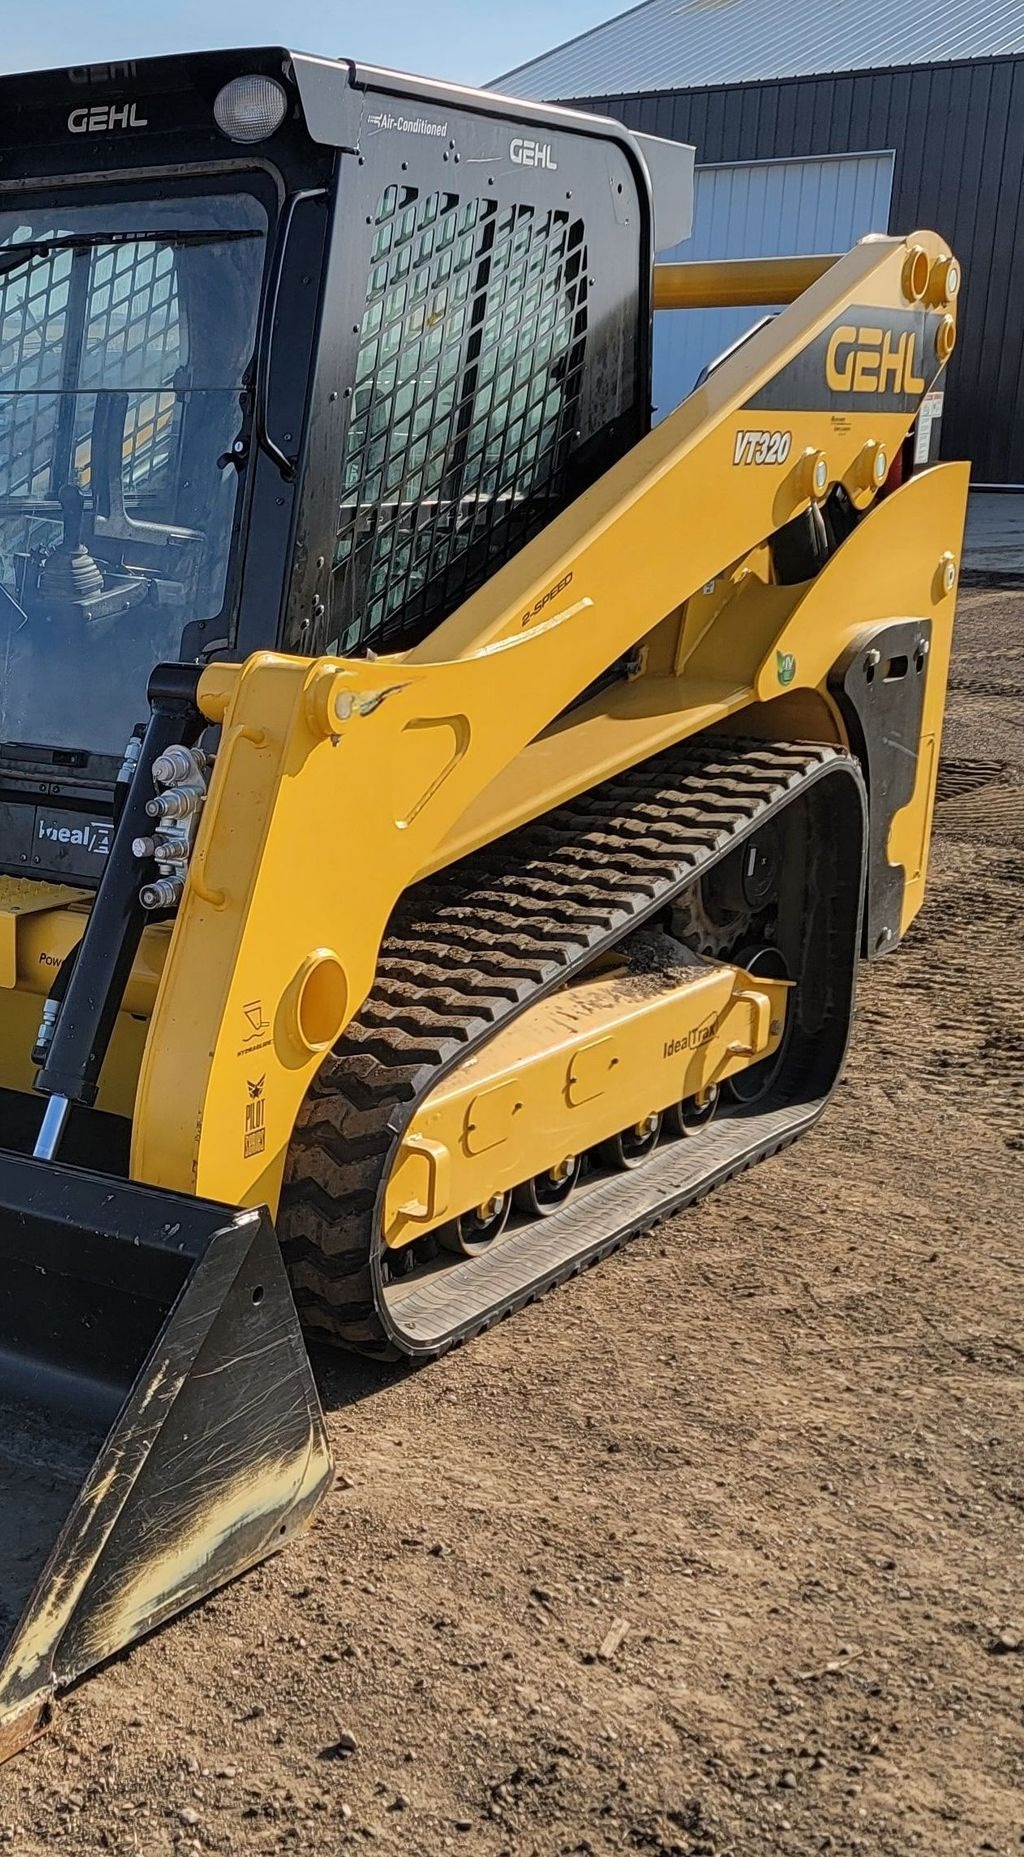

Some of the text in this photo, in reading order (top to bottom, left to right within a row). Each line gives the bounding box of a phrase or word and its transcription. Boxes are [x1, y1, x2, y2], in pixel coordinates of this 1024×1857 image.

[67, 102, 148, 134] GEHL
[380, 113, 448, 137] Air-Conditioned
[509, 137, 558, 171] GEHL
[825, 325, 926, 395] GEHL
[733, 430, 793, 466] VT320
[521, 572, 574, 628] 2-SPEED
[39, 952, 63, 968] Pow
[245, 1098, 266, 1133] PILOT
